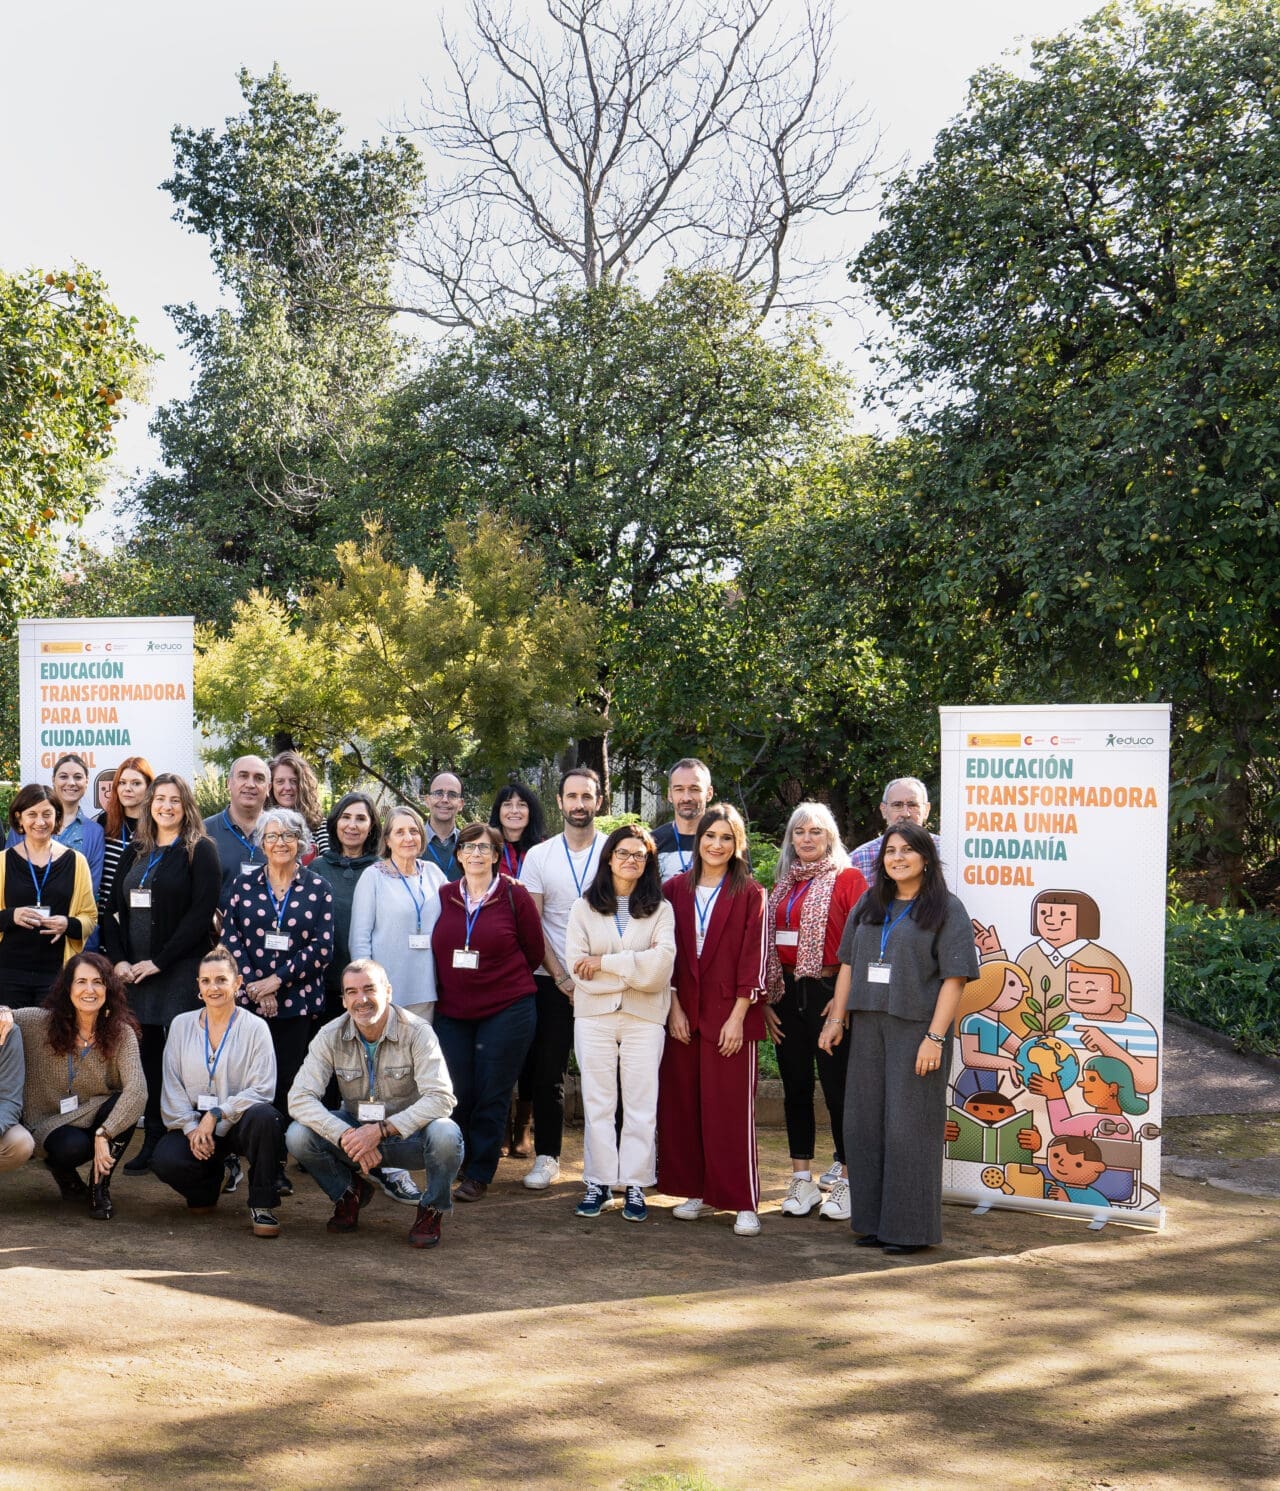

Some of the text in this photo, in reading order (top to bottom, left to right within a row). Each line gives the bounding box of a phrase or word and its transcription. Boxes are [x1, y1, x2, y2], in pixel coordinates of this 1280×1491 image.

[155, 642, 183, 650] educo
[40, 659, 124, 680] EDUCACIÓN
[40, 683, 186, 702] TRANSFORMADORA
[41, 706, 118, 724] PARA UNA
[40, 729, 131, 747] CIUDADANIA
[1116, 736, 1154, 745] educo
[41, 751, 96, 769] GLAL
[966, 754, 1073, 779] EDUCACIÓN
[965, 785, 1158, 808] TRANSFORMADORA
[965, 811, 1079, 834] PARA UNHA
[964, 836, 1068, 861] CIDADANÍA
[963, 864, 1035, 887] GLOBAL
